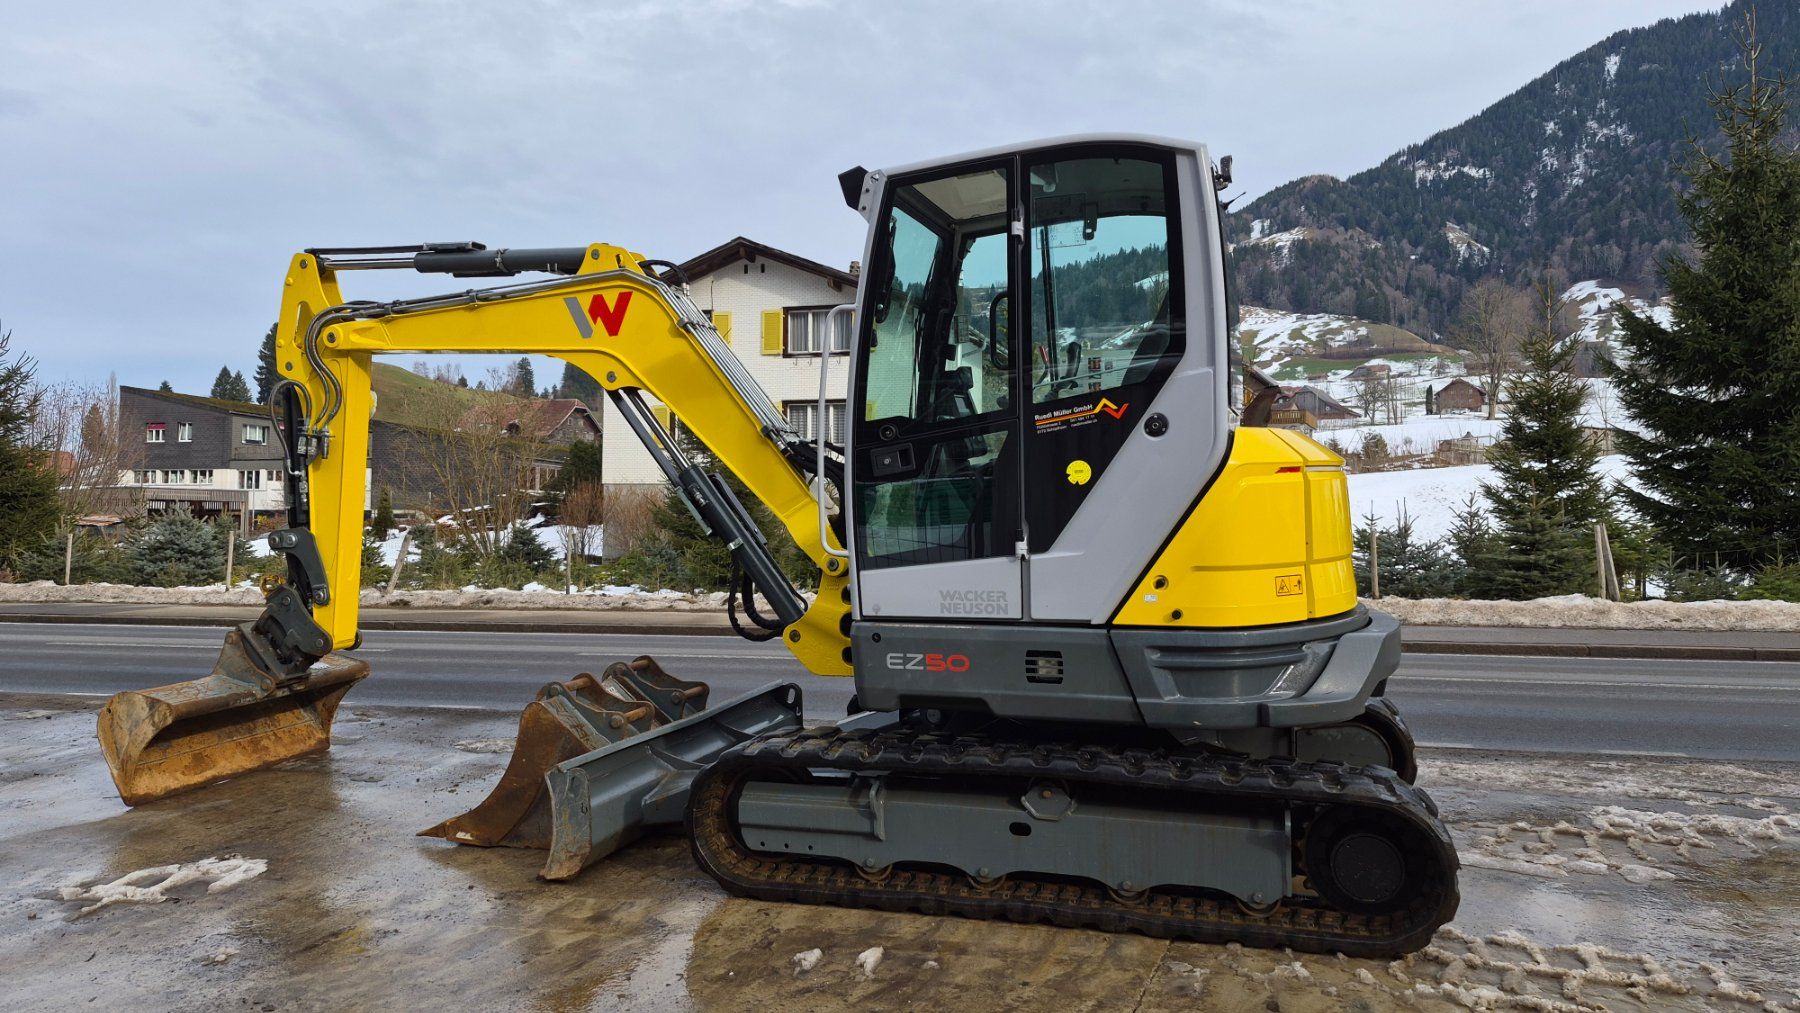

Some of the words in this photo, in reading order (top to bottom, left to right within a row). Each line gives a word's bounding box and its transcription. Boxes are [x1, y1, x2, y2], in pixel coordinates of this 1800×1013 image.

[1034, 412, 1053, 421] Ruedi
[1053, 408, 1072, 417] Müller
[1073, 404, 1093, 413] GmbH
[939, 589, 1009, 602] WACKER
[939, 602, 1009, 615] NEUSON
[886, 653, 970, 672] EZ50
